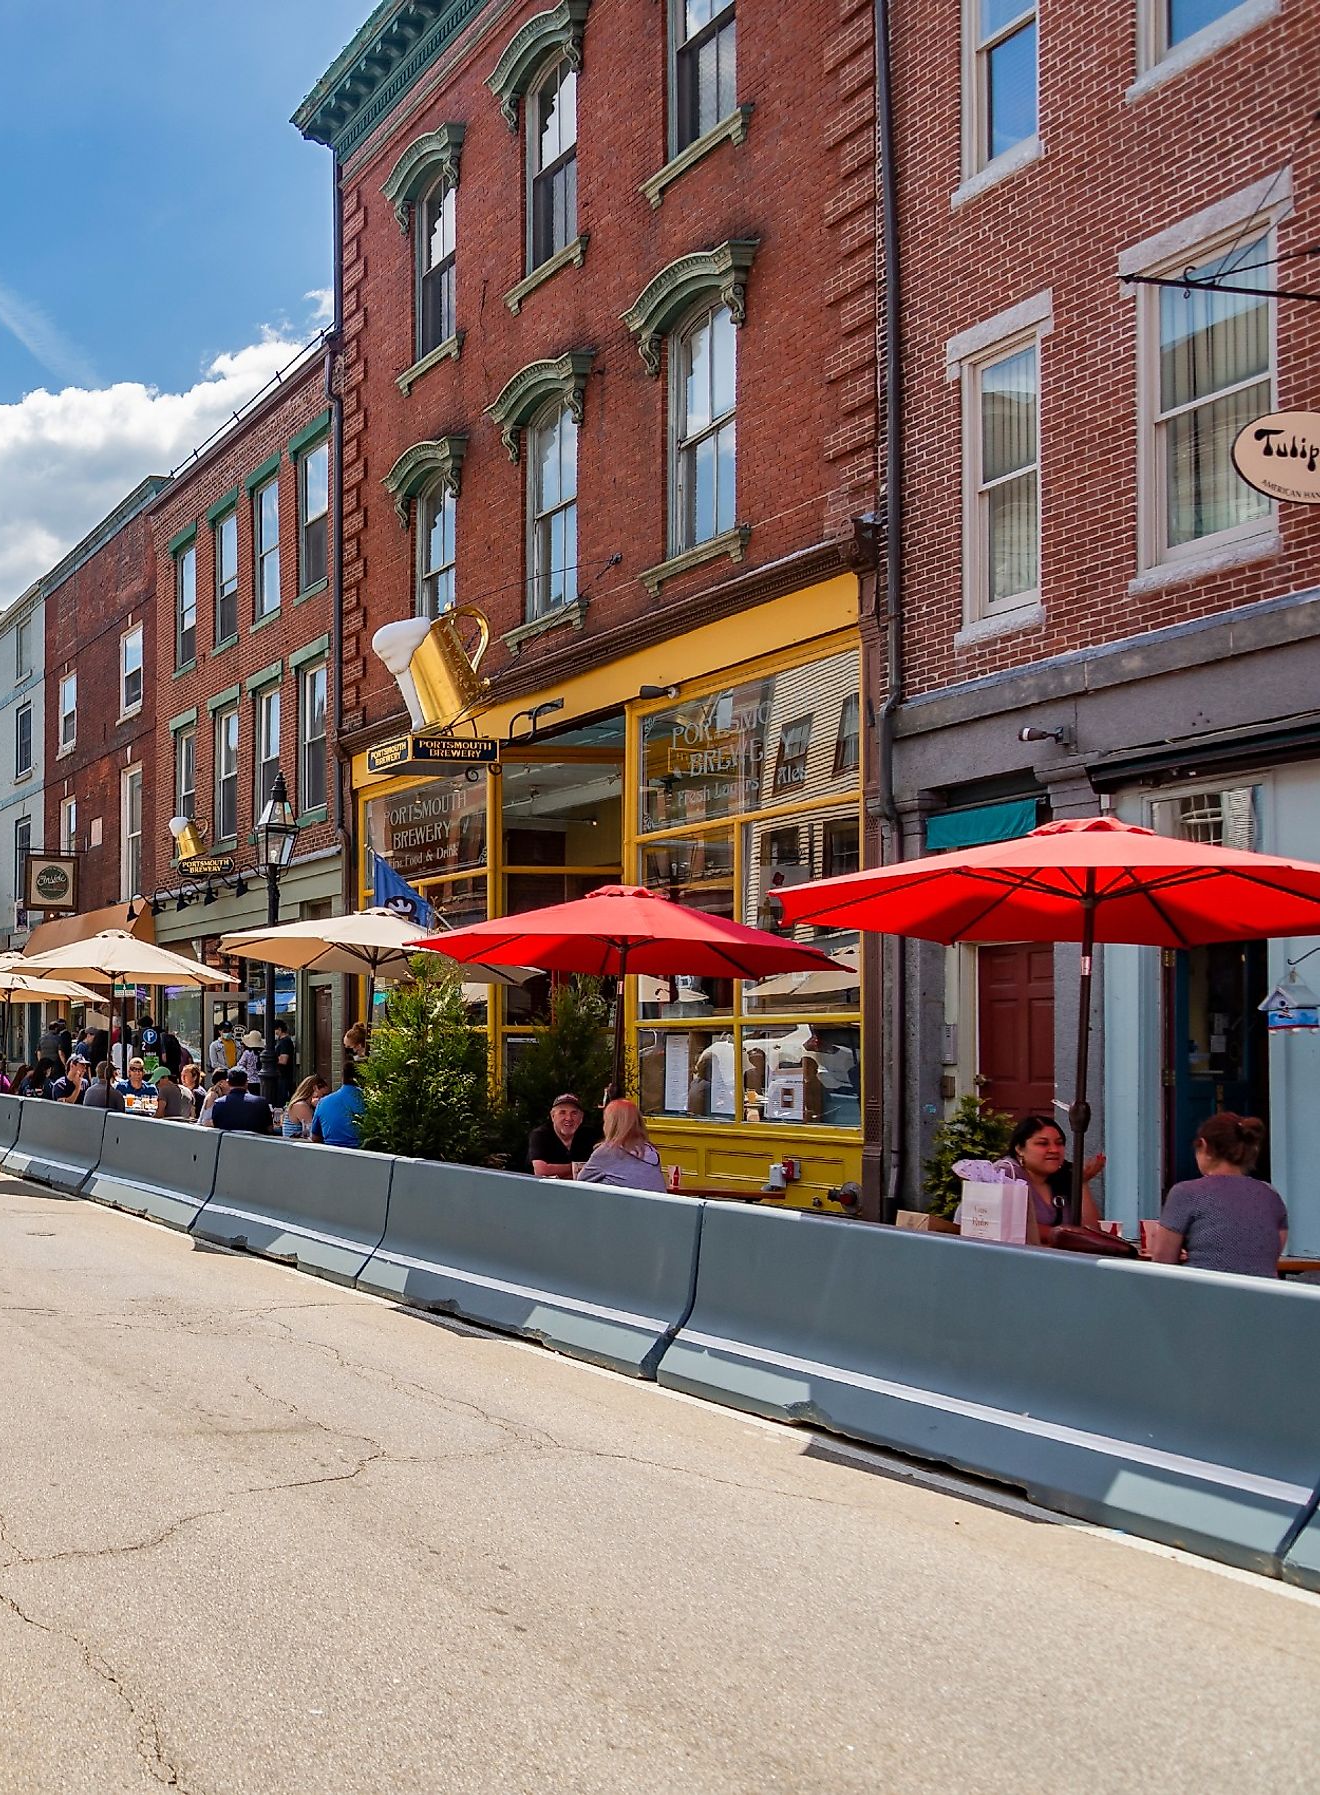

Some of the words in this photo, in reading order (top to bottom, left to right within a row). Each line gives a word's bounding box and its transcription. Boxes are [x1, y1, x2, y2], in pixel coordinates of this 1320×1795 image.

[1262, 479, 1302, 497] AMERICAN
[370, 742, 407, 760] PORTSMOUTH
[418, 740, 492, 750] PORTSMOUTH
[429, 749, 482, 758] BREWERY
[375, 752, 401, 766] BREWERY
[777, 765, 807, 785] Ales
[384, 790, 467, 826] PORTSMOUTH
[392, 820, 452, 851] BREWERY
[182, 859, 230, 867] PORTSMOUTH
[406, 852, 423, 867] Food
[425, 849, 434, 862] &
